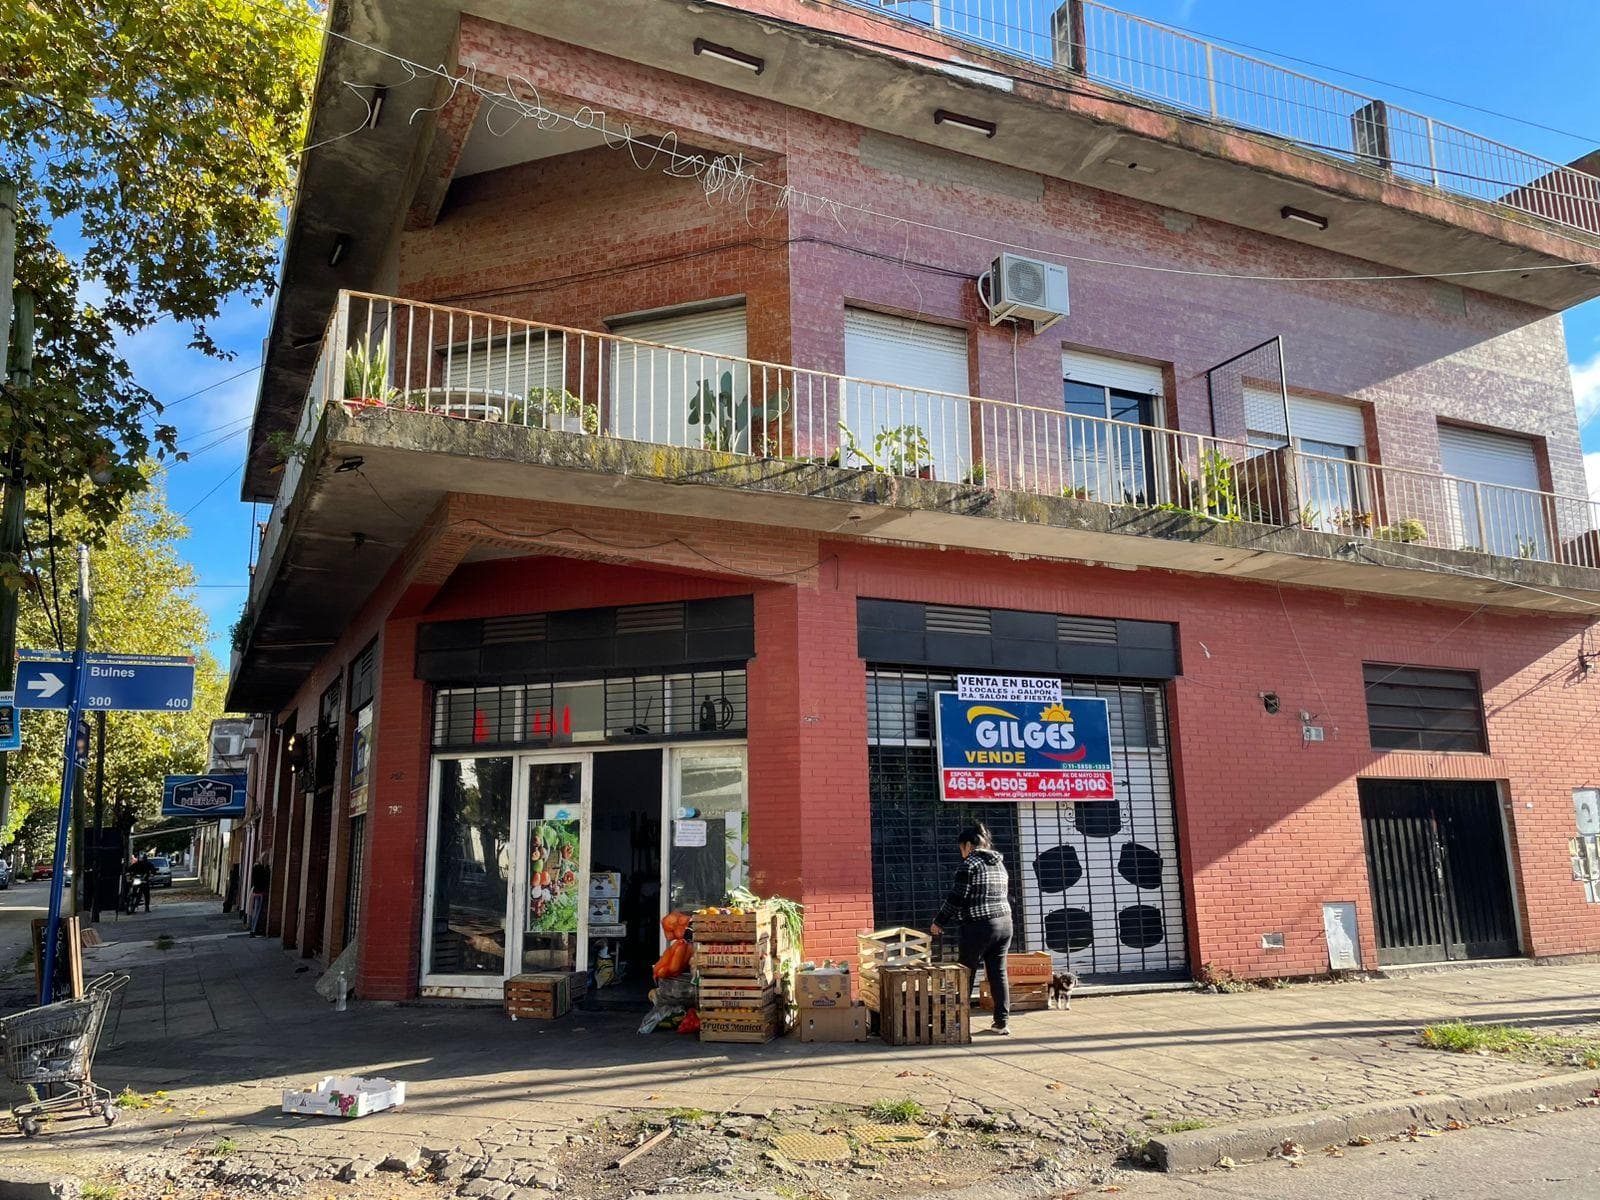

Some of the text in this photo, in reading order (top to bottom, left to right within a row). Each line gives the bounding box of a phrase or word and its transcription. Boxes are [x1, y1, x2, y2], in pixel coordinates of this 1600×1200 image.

[91, 666, 135, 678] Bulnes
[960, 677, 1060, 689] VENTA EN BLOCK
[88, 696, 188, 708] 300 400
[975, 720, 1076, 750] GILGES
[965, 751, 1026, 764] VENDE
[949, 778, 1107, 791] 4654-0505 4441-8100
[181, 796, 227, 806] HERAS
